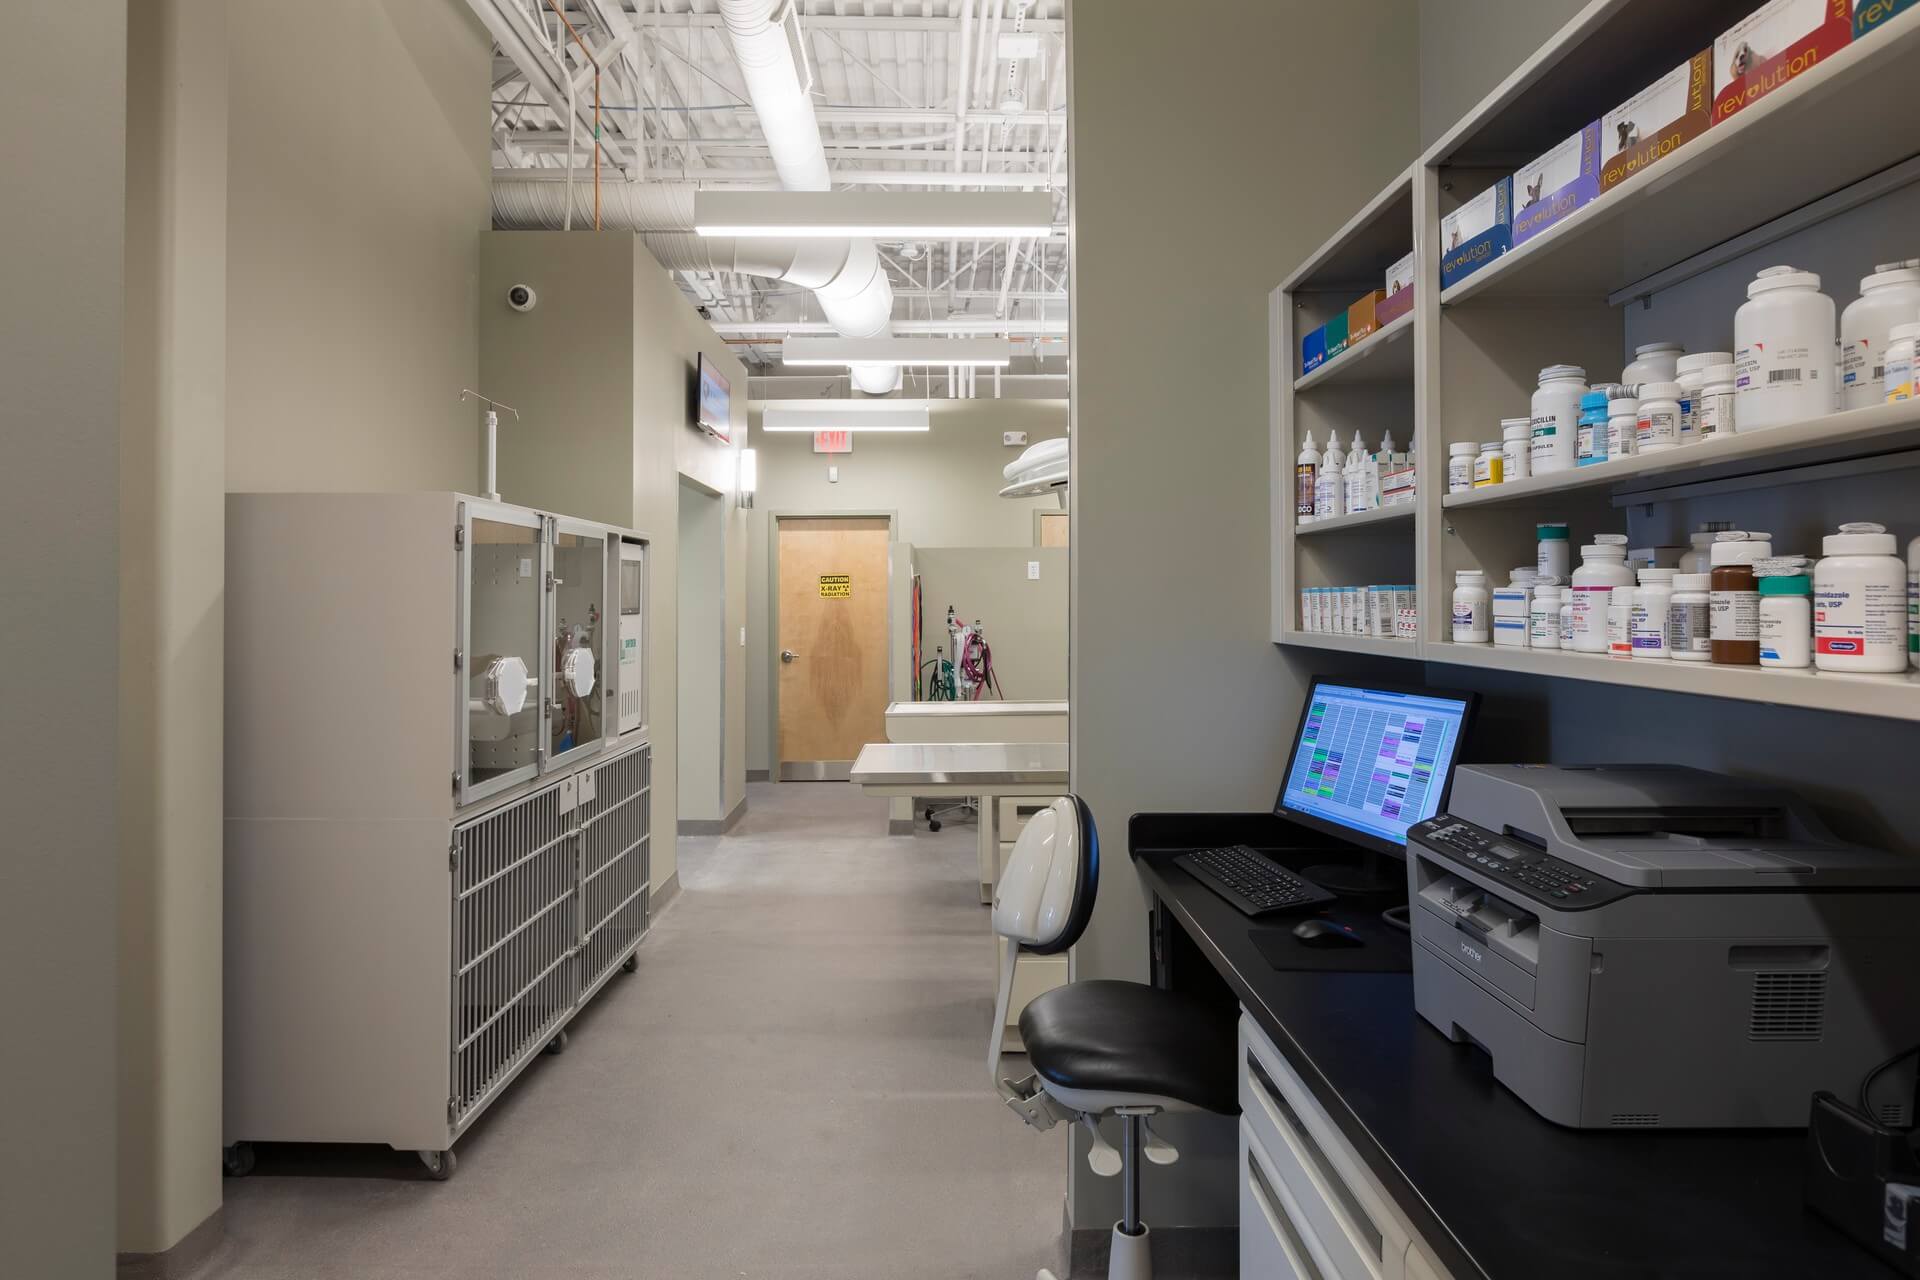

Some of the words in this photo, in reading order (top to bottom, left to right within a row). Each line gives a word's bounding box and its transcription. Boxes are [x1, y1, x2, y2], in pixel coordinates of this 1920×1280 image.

[1717, 47, 1818, 119] revolution
[1602, 133, 1682, 186] revolution
[1515, 193, 1577, 237] revolution
[1442, 239, 1492, 274] revolution
[1461, 941, 1481, 961] brother
